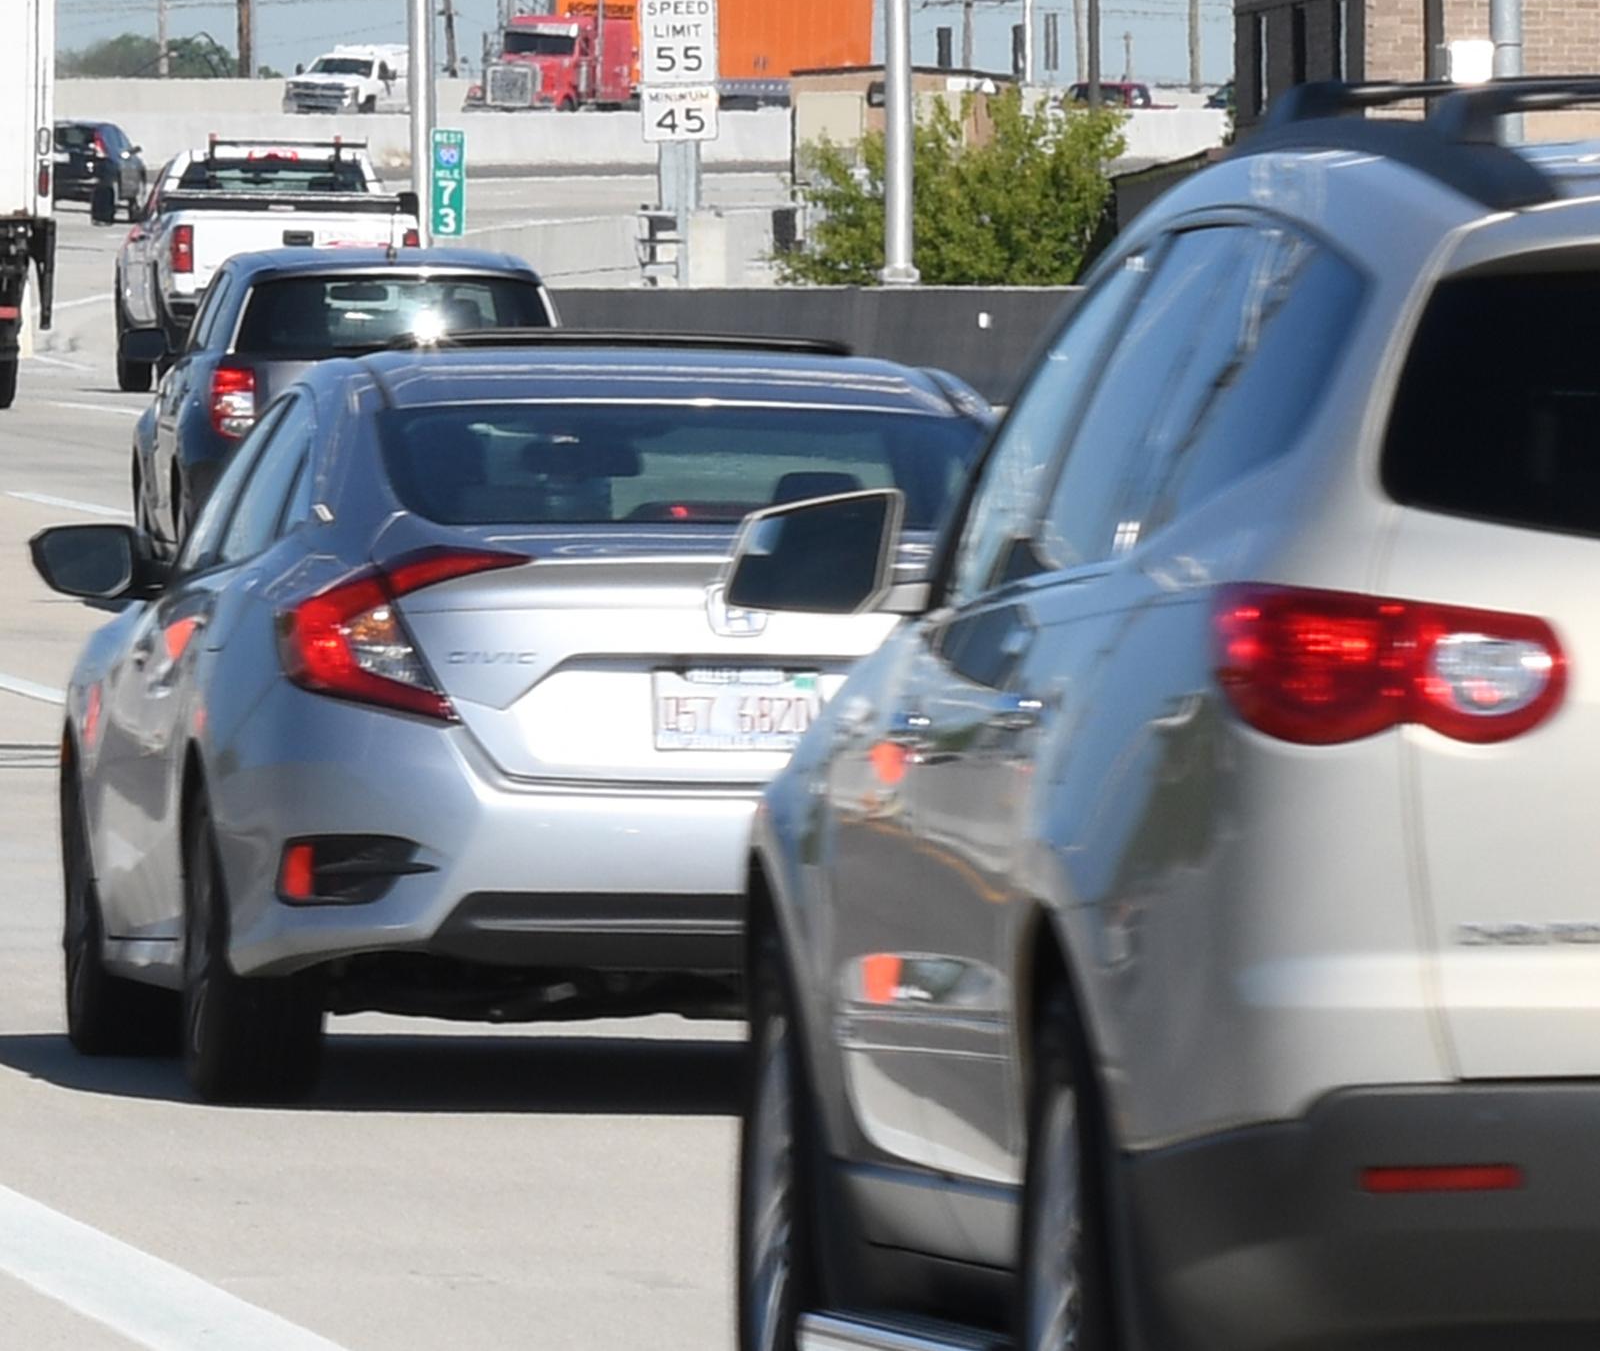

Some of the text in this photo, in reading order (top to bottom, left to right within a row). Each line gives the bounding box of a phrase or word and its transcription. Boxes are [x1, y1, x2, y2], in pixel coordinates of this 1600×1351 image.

[647, 1, 709, 16] SPEED
[653, 24, 702, 38] LIMIT
[656, 46, 702, 72] 55
[655, 108, 705, 134] 45
